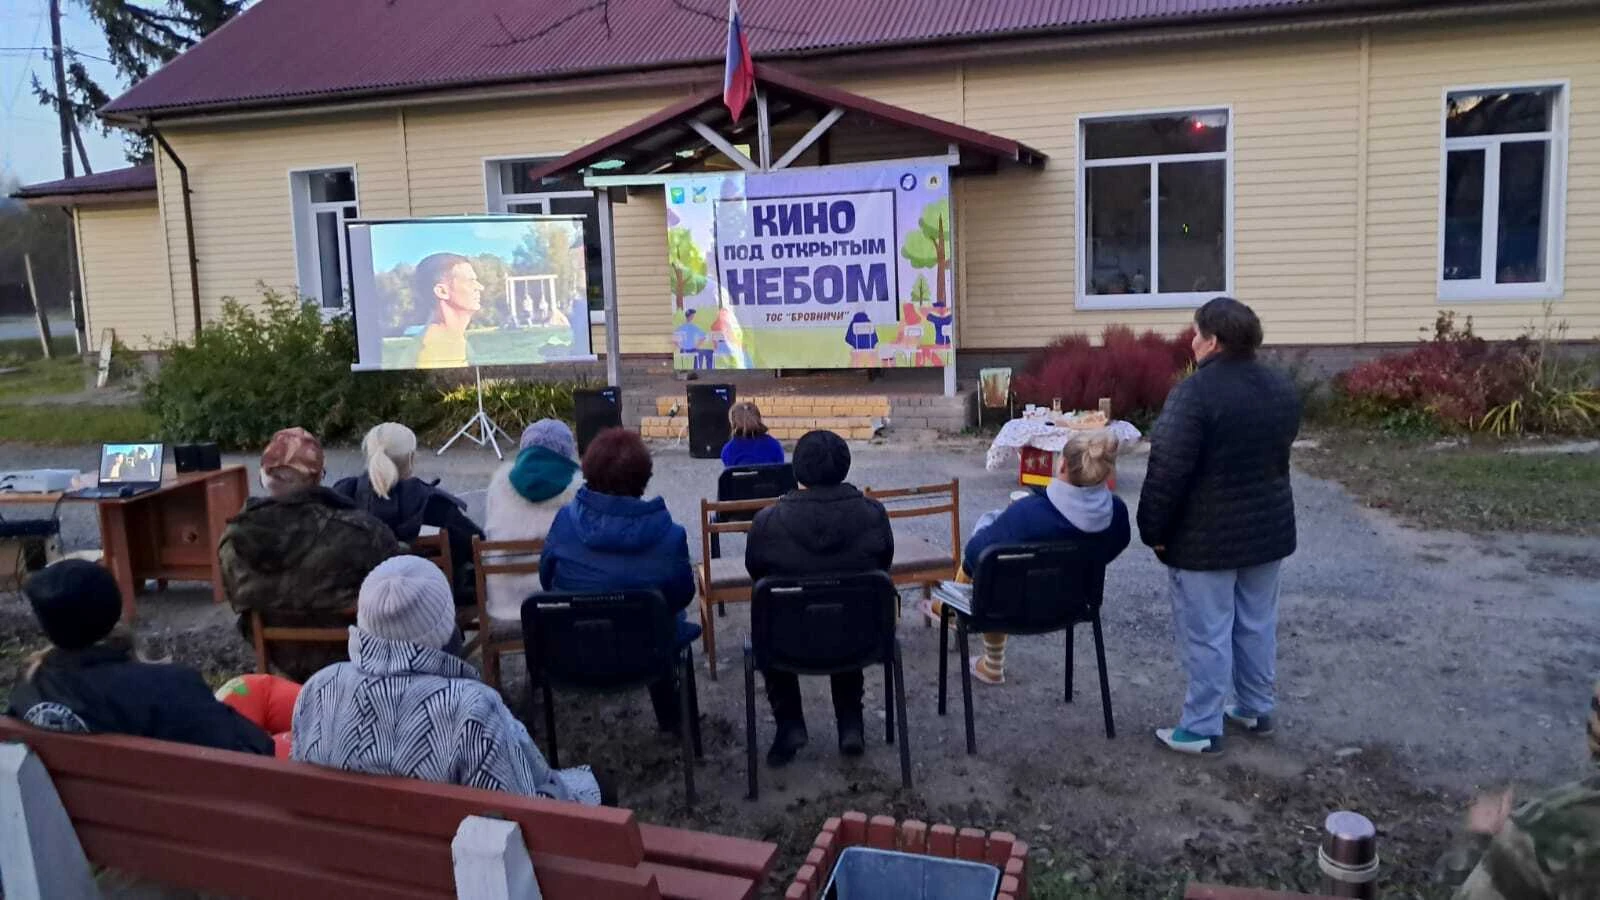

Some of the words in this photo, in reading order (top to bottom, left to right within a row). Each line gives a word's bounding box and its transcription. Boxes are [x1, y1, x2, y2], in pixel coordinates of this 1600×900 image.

[753, 200, 855, 236] КИНО
[724, 245, 764, 261] ПОД
[772, 238, 886, 259] ОТКРЫТЫМ
[726, 263, 889, 305] НЕБОМ
[765, 312, 783, 322] ТОС
